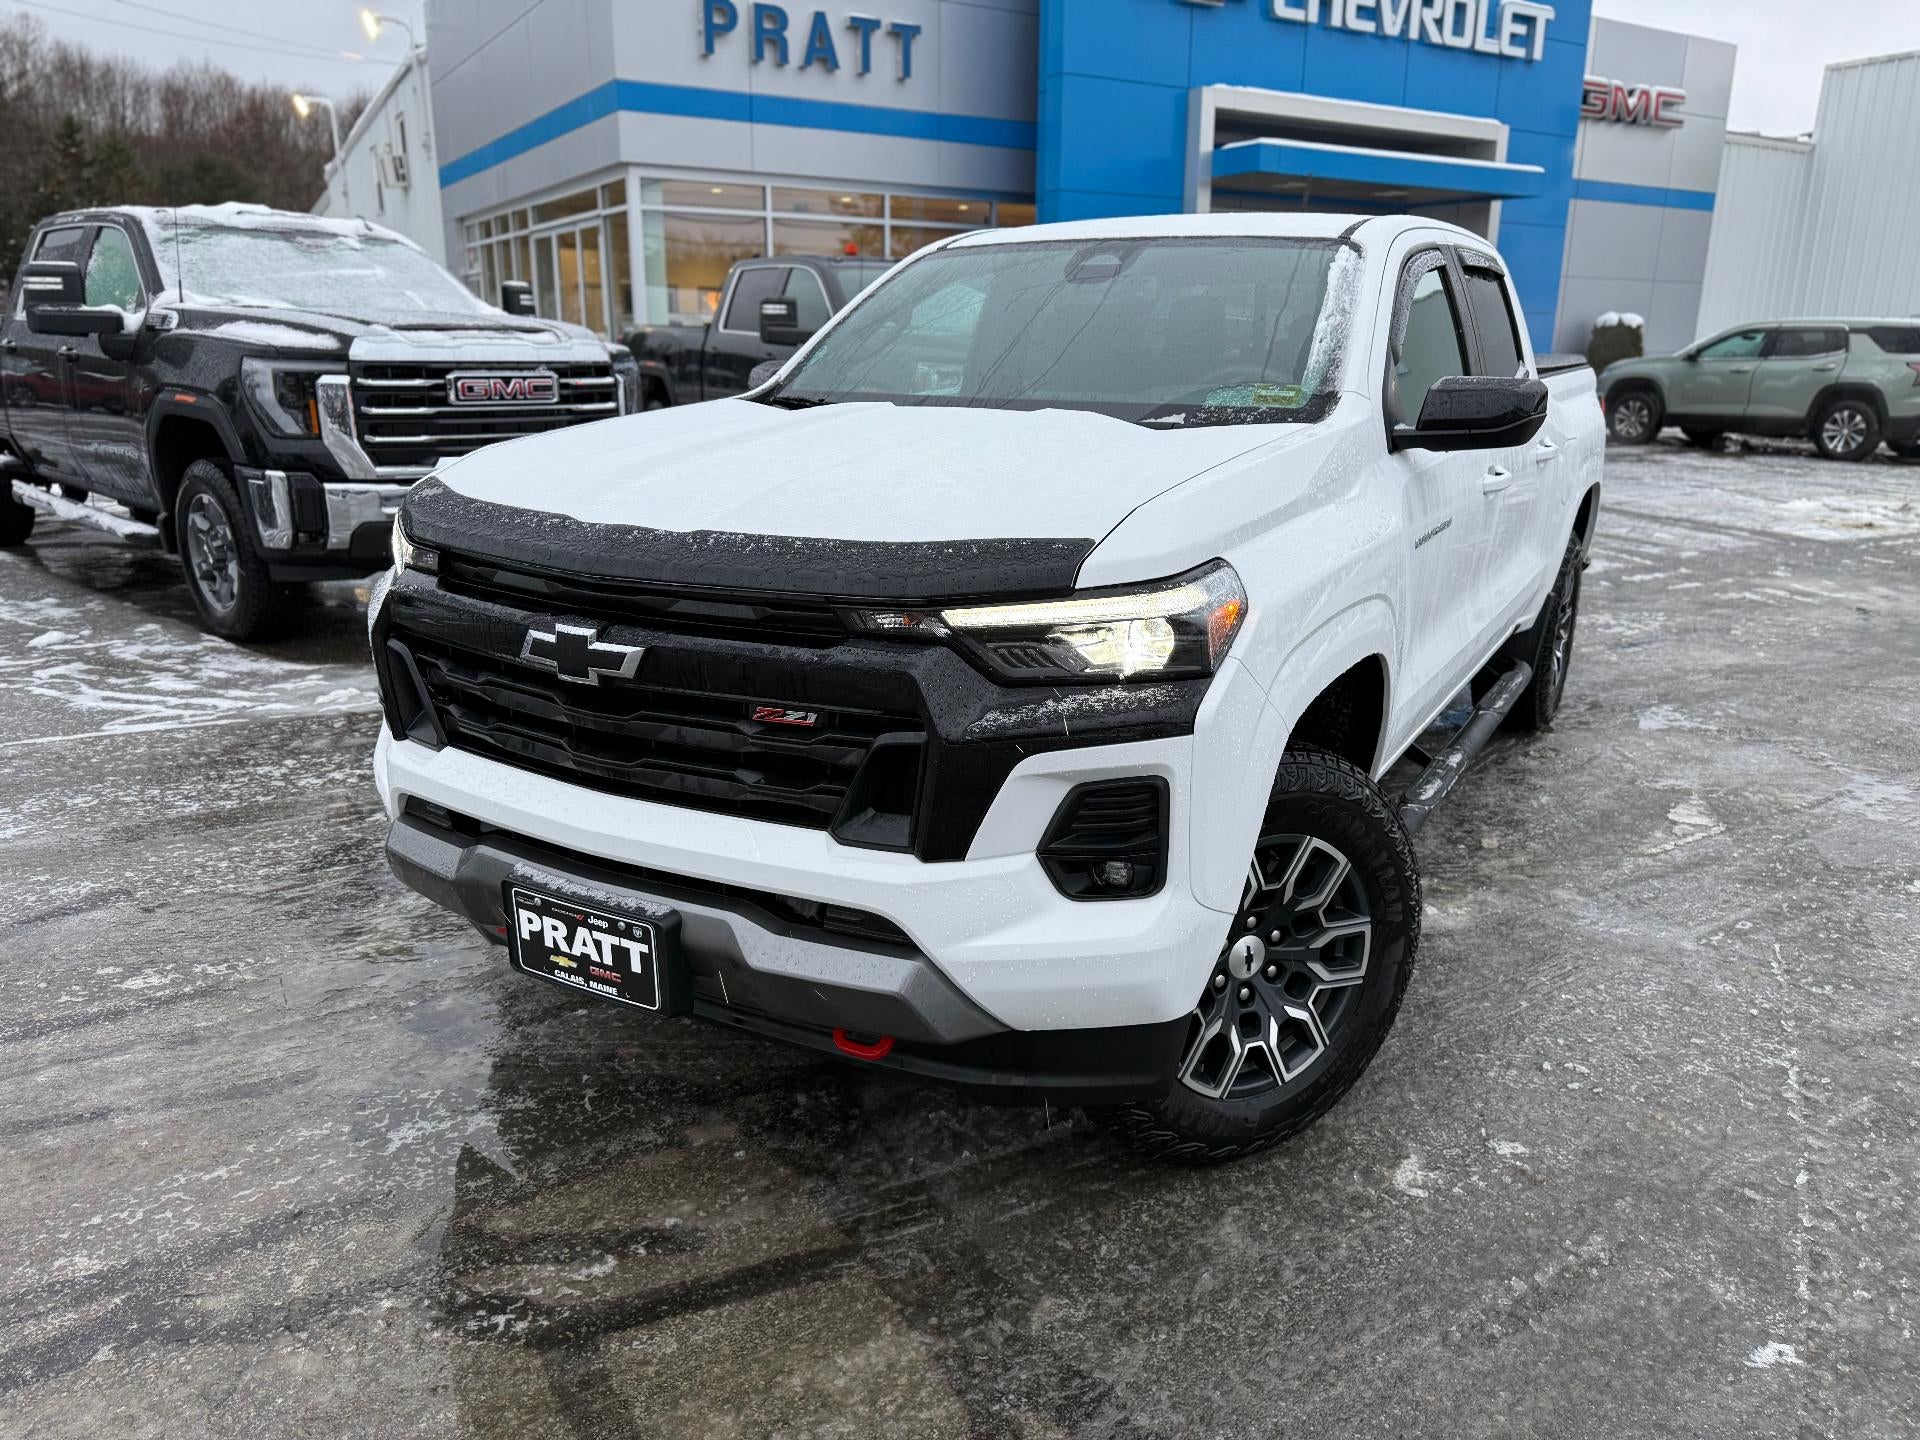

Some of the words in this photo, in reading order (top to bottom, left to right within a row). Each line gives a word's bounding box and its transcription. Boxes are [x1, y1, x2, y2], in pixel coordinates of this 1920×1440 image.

[700, 0, 922, 80] PRATT
[1581, 75, 1687, 127] GMC
[457, 378, 553, 400] GMC
[752, 706, 818, 727] Z71
[588, 915, 609, 929] Jeep
[518, 908, 650, 974] PRATT
[554, 969, 588, 988] CALAIS,
[589, 980, 618, 996] MAINE
[590, 965, 622, 983] GMC
